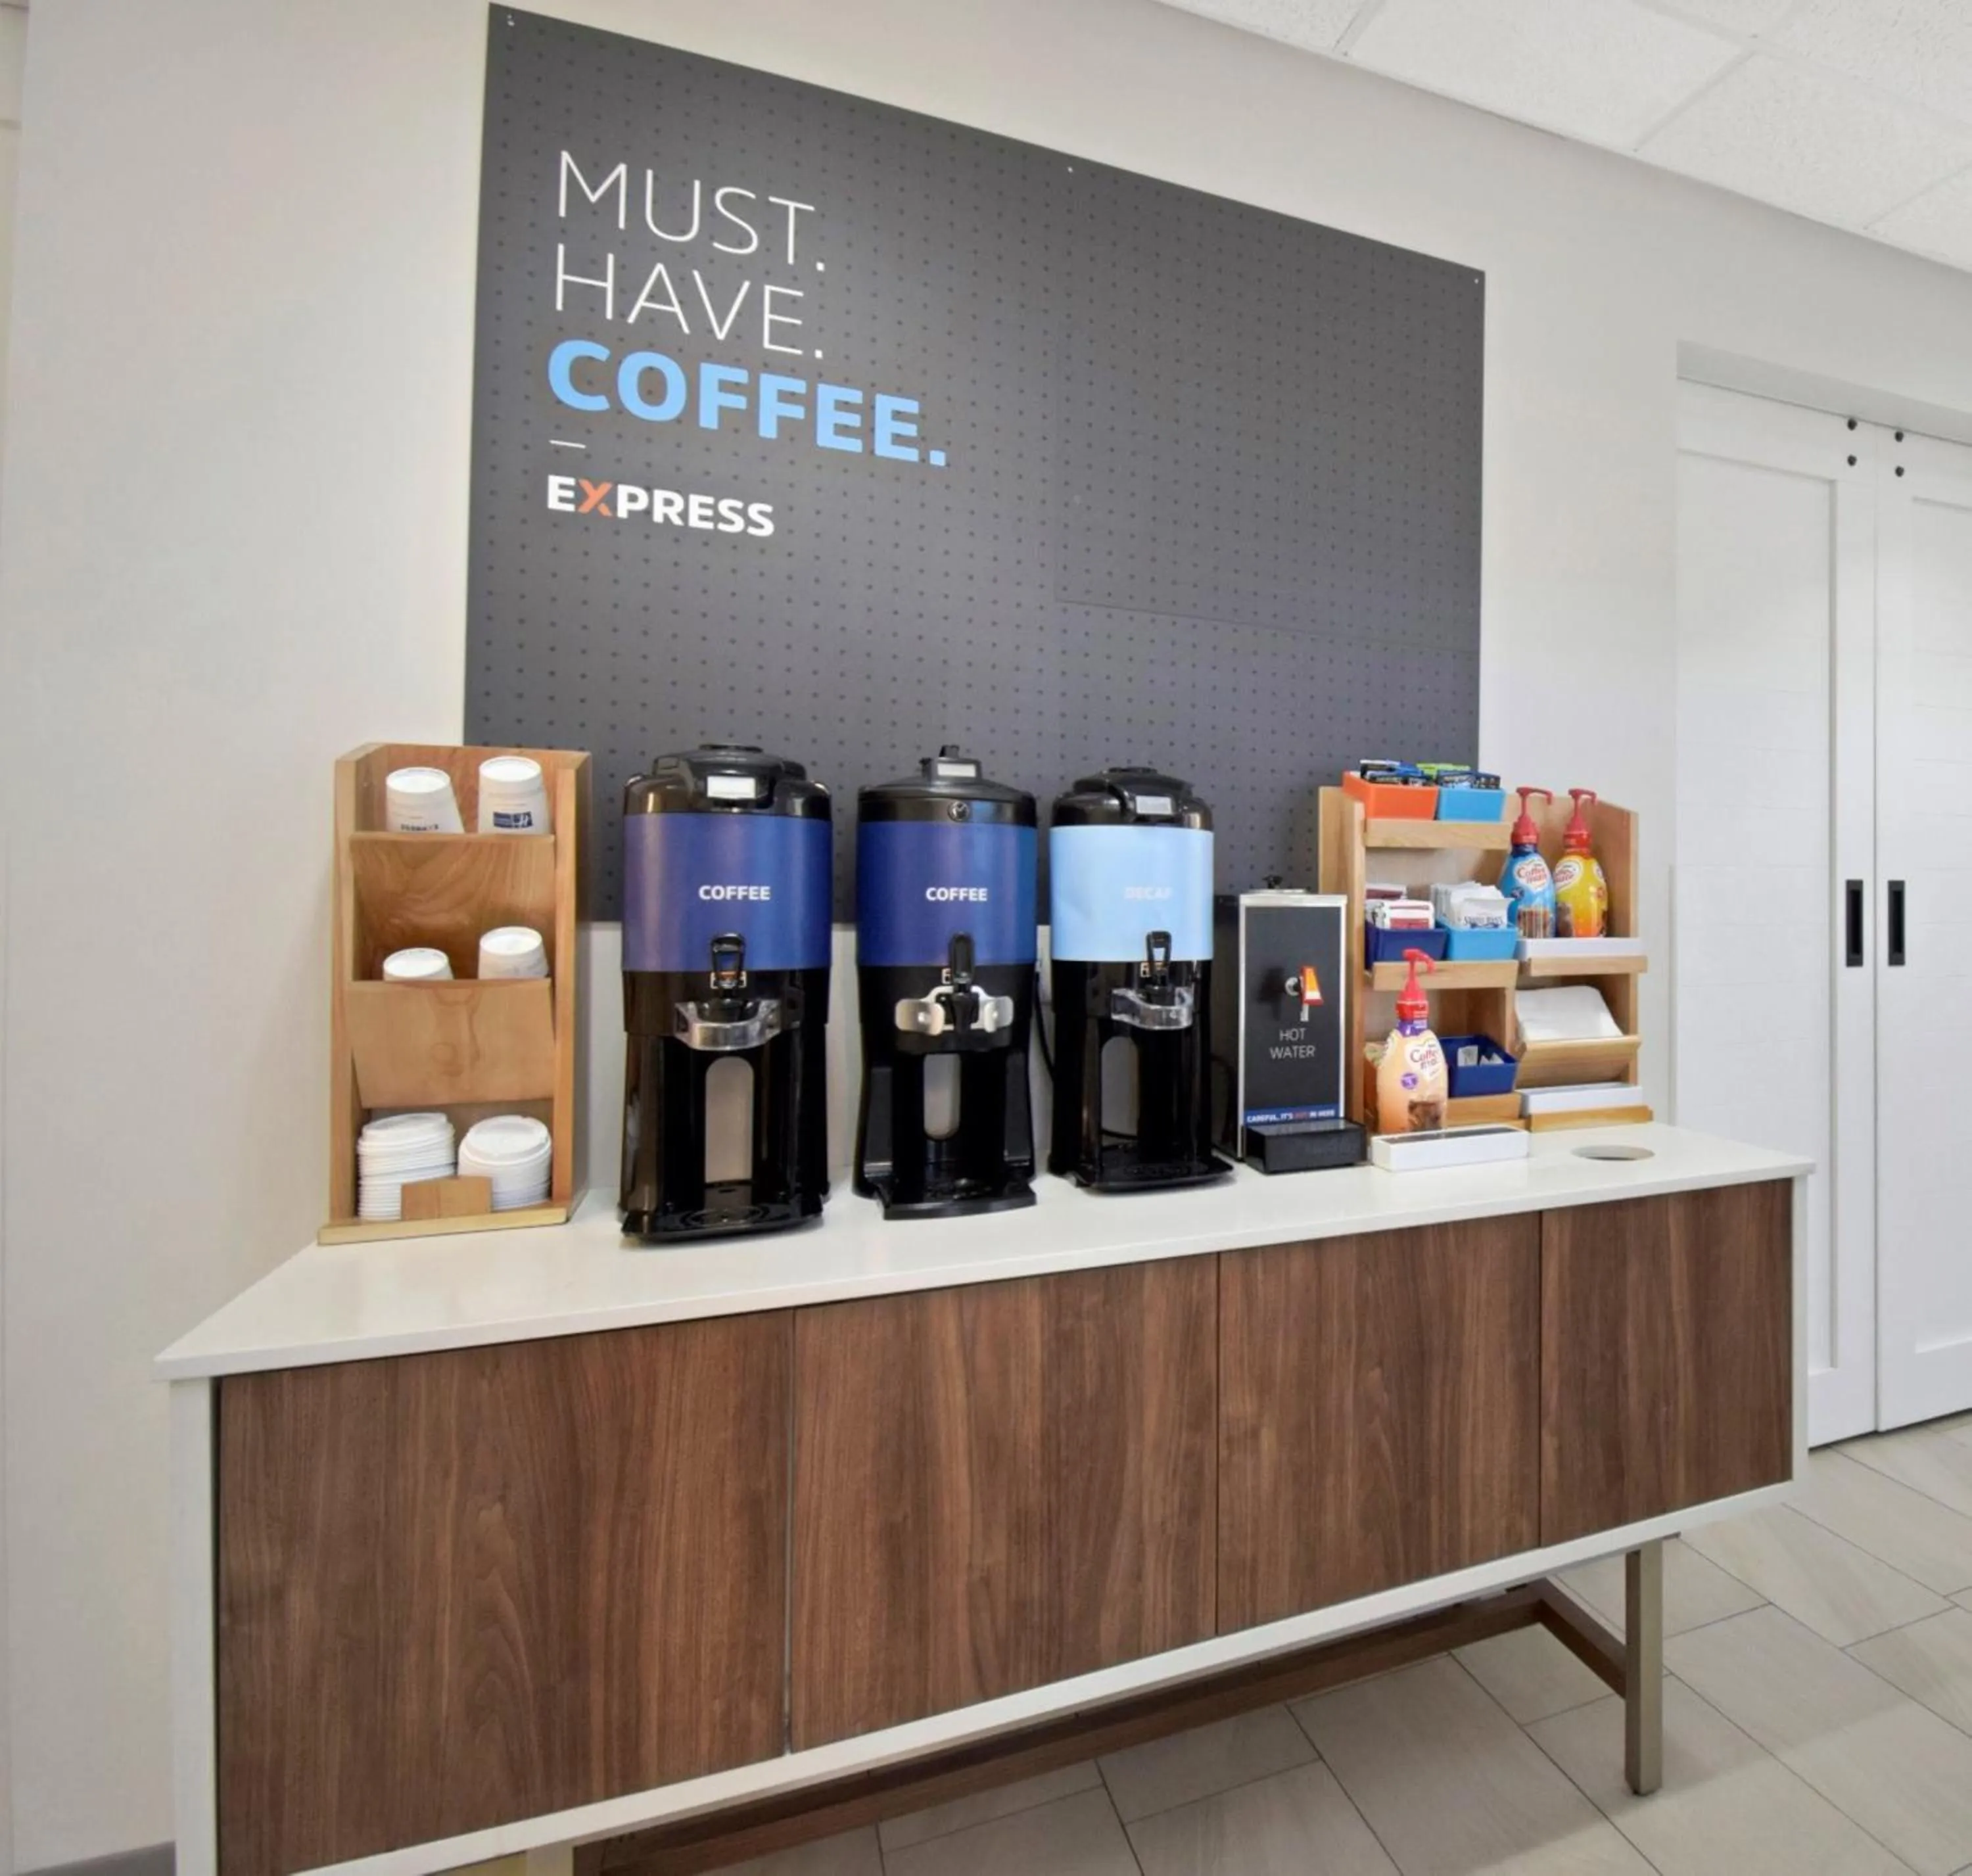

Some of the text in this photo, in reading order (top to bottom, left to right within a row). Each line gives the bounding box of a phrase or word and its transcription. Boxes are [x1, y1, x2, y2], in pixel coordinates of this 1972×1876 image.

[559, 151, 825, 271] MUST.
[556, 243, 823, 359] HAVE.
[548, 339, 946, 466] COFFEE.
[548, 475, 775, 537] EXPRESS
[699, 885, 770, 900] COFFEE
[926, 887, 987, 901] COFFEE
[1124, 887, 1173, 900] DECAF
[1279, 1027, 1307, 1042] HOT
[1269, 1045, 1315, 1060] WATER
